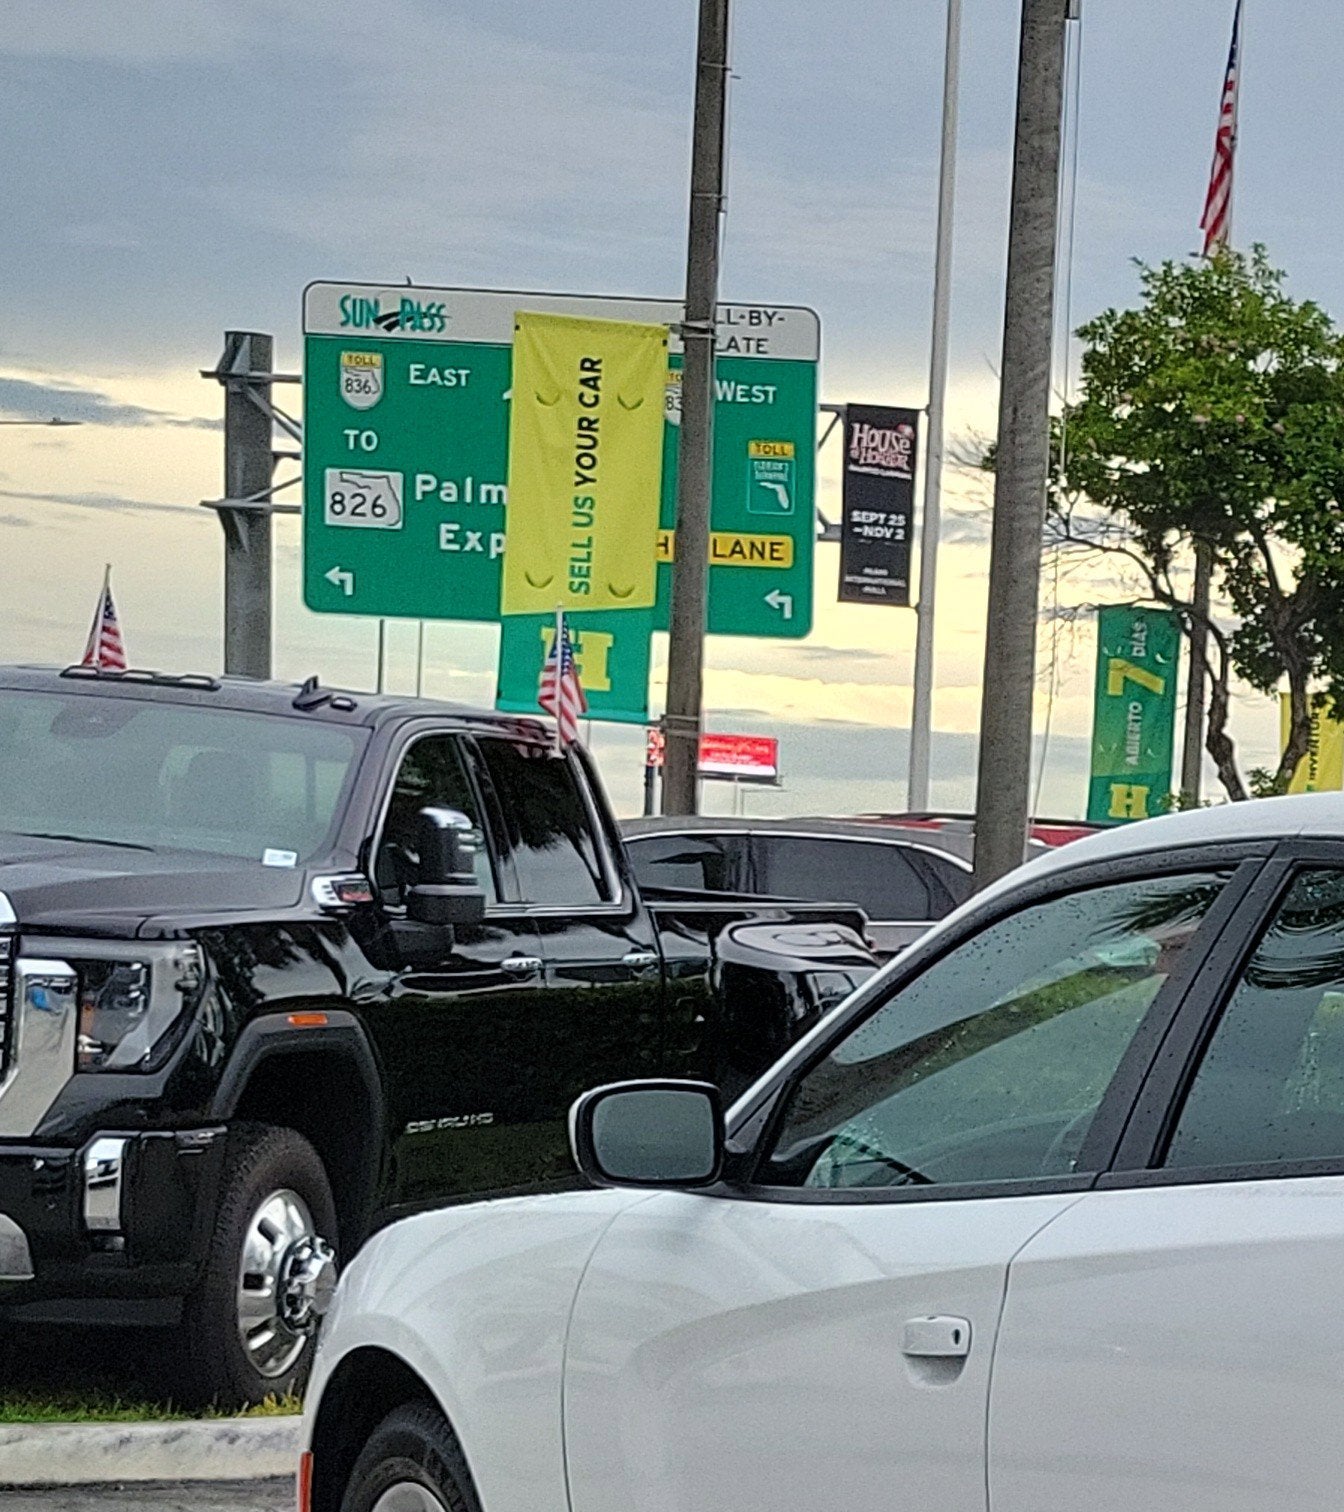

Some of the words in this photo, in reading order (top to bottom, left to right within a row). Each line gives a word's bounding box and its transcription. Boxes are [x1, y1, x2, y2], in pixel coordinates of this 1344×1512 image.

[346, 354, 376, 366] TOLL
[344, 377, 373, 395] 836
[408, 363, 471, 388] EAST
[578, 356, 603, 410] CAR
[715, 380, 778, 405] WEST
[343, 429, 378, 451] TO
[574, 415, 600, 488] YOUR
[755, 443, 789, 456] TOLL
[415, 473, 508, 506] Palm
[329, 492, 388, 518] 826
[572, 495, 596, 528] US
[438, 522, 507, 560] Exp
[712, 538, 785, 561] LANE
[569, 535, 595, 596] SELL
[1107, 657, 1166, 697] 7
